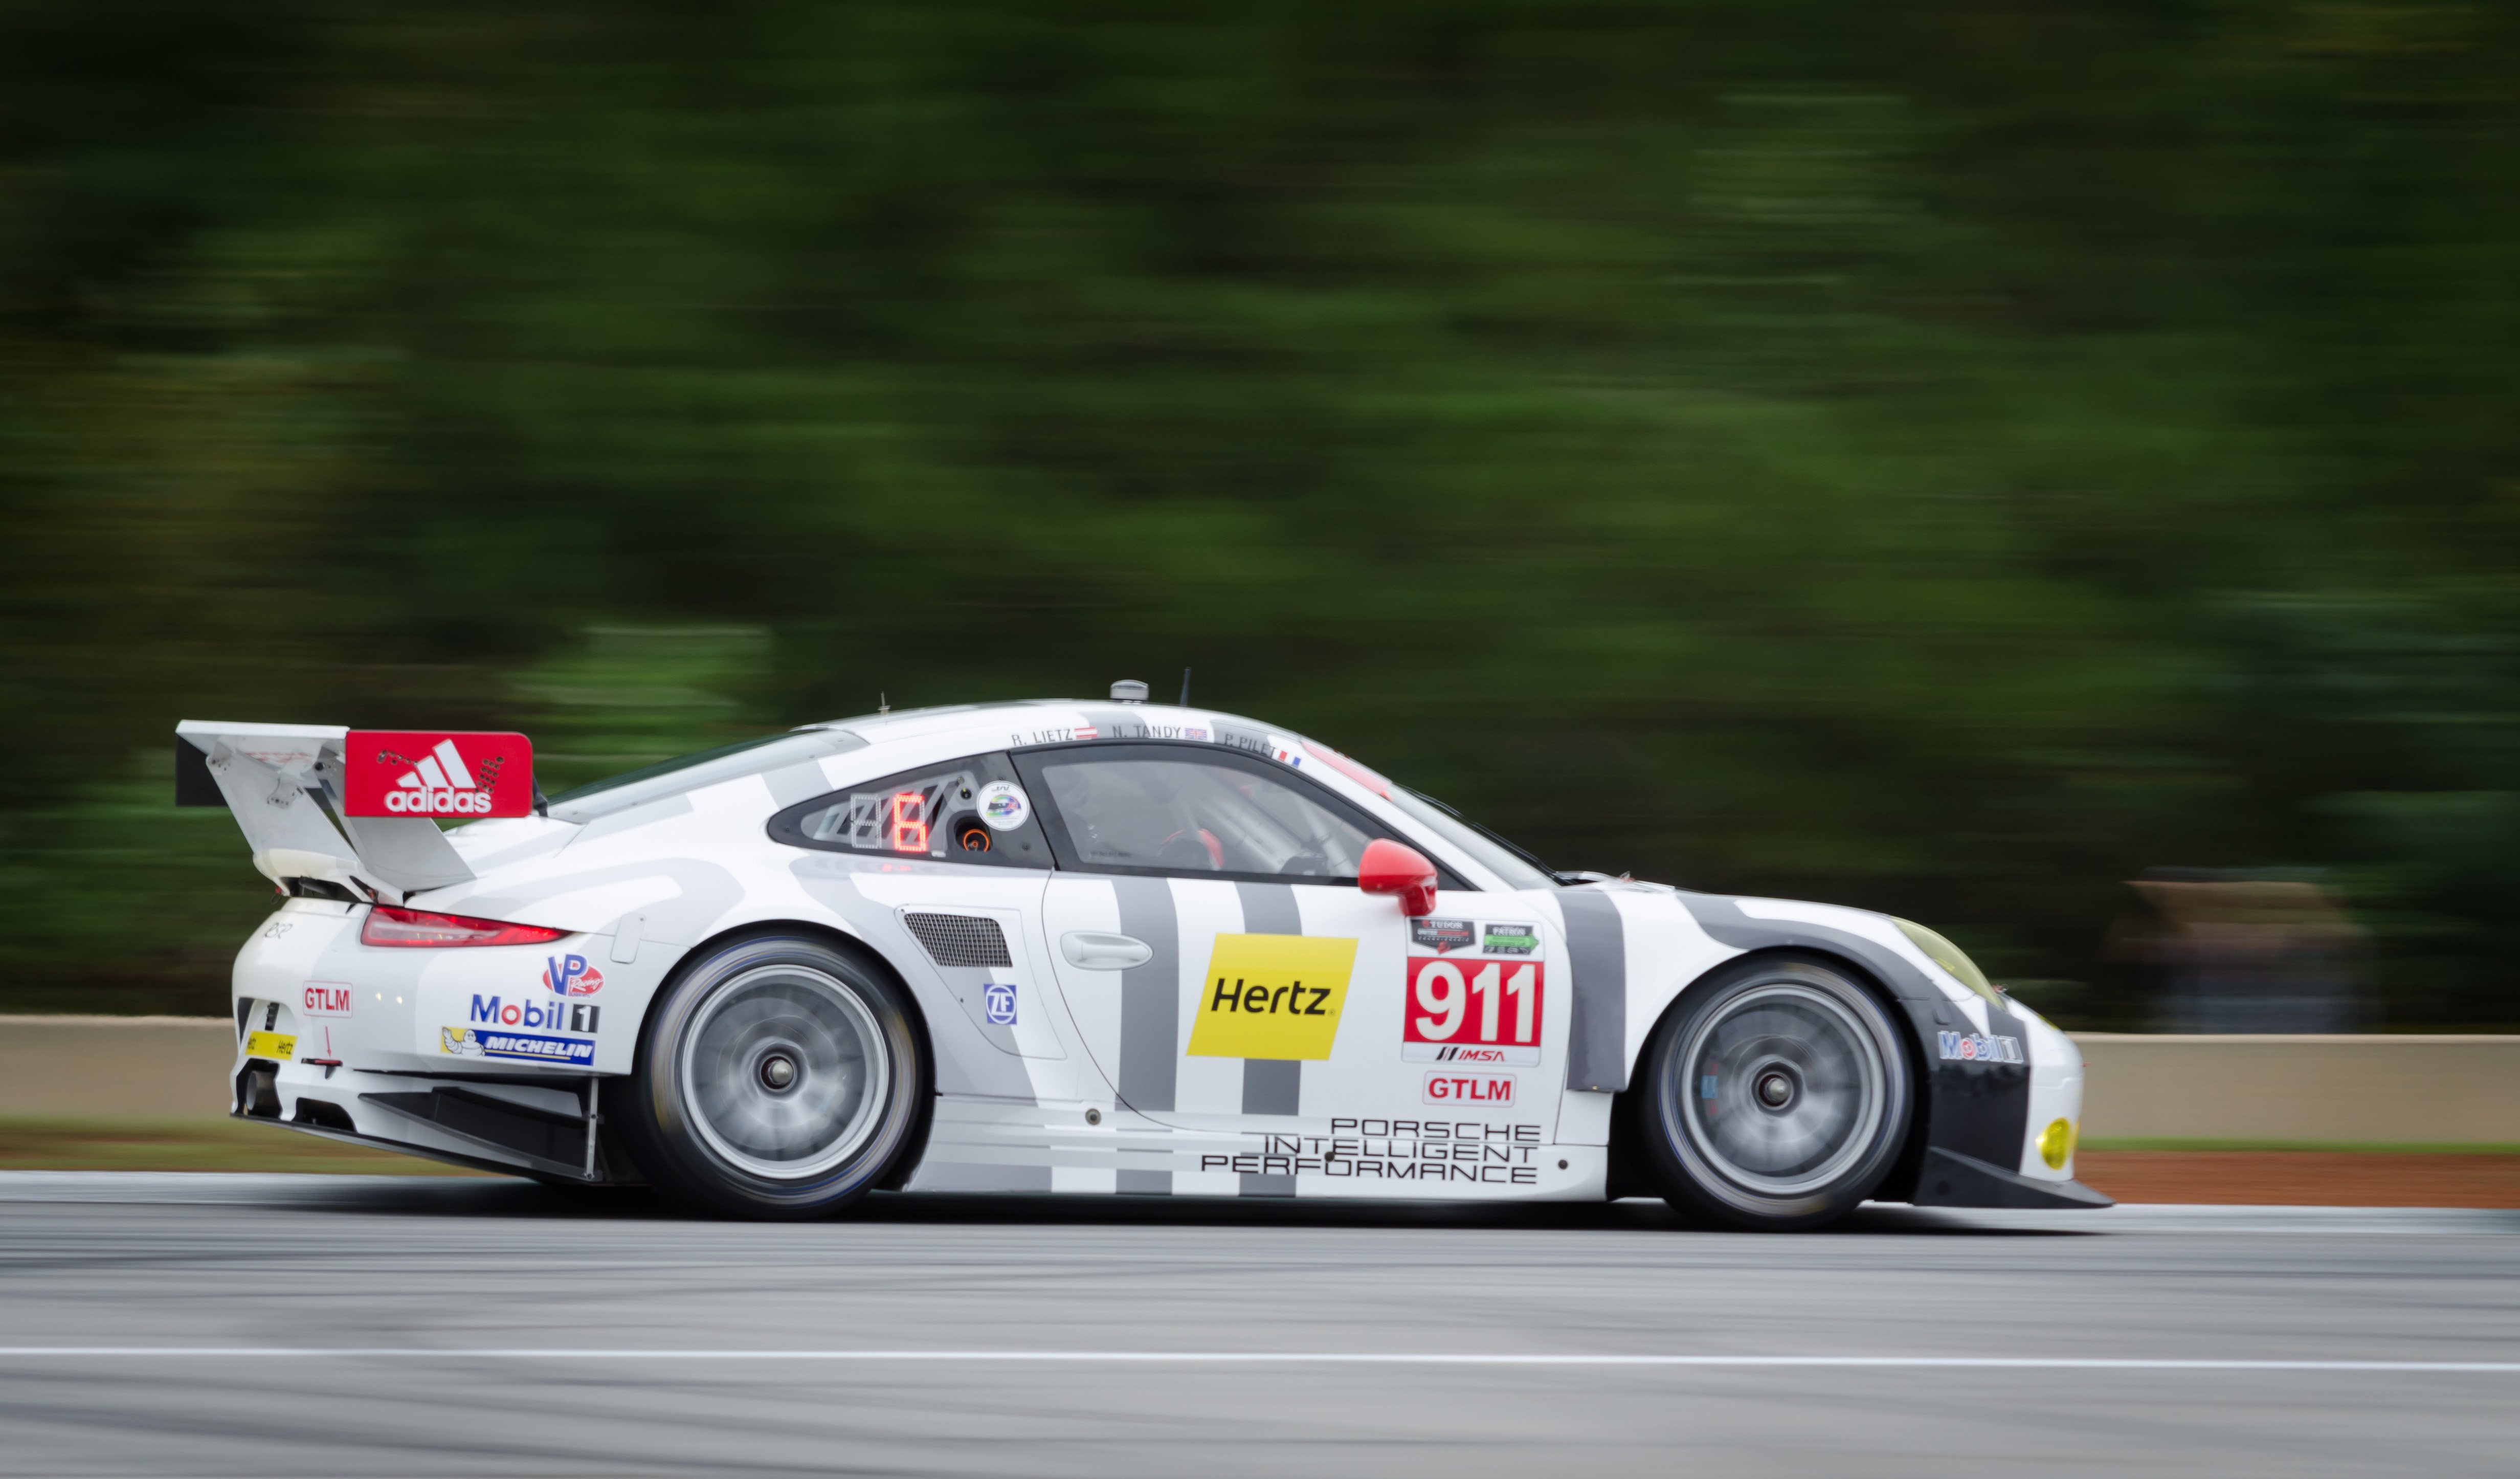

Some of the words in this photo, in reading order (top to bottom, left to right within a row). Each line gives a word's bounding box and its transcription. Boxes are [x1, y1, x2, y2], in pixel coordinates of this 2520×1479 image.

[1011, 734, 1028, 746] R.
[1033, 729, 1073, 743] LIETZ
[1112, 725, 1127, 738] N.
[1133, 725, 1180, 739] TANDY
[1224, 733, 1233, 746] P.
[1238, 736, 1277, 759] PILET
[385, 786, 492, 813] adidas
[894, 794, 927, 851] 6
[1430, 920, 1463, 929] TUDOR
[548, 954, 588, 996] VP
[569, 977, 604, 992] Racing
[305, 987, 350, 1011] GTLM
[989, 992, 1013, 1016] ZF
[1211, 978, 1331, 1016] Hertz
[1415, 960, 1535, 1043] 911
[471, 994, 565, 1030] Mobil
[576, 1005, 592, 1032] 1
[485, 1035, 593, 1058] MICHELIN
[1458, 1050, 1505, 1062] IMSA
[1937, 1030, 2004, 1061] Mobil
[1429, 1077, 1511, 1101] GTLM
[1331, 1118, 1542, 1142] PORSCHE
[1265, 1135, 1538, 1163] INTELLIGENT
[1201, 1155, 1538, 1184] PERFORMANCE
